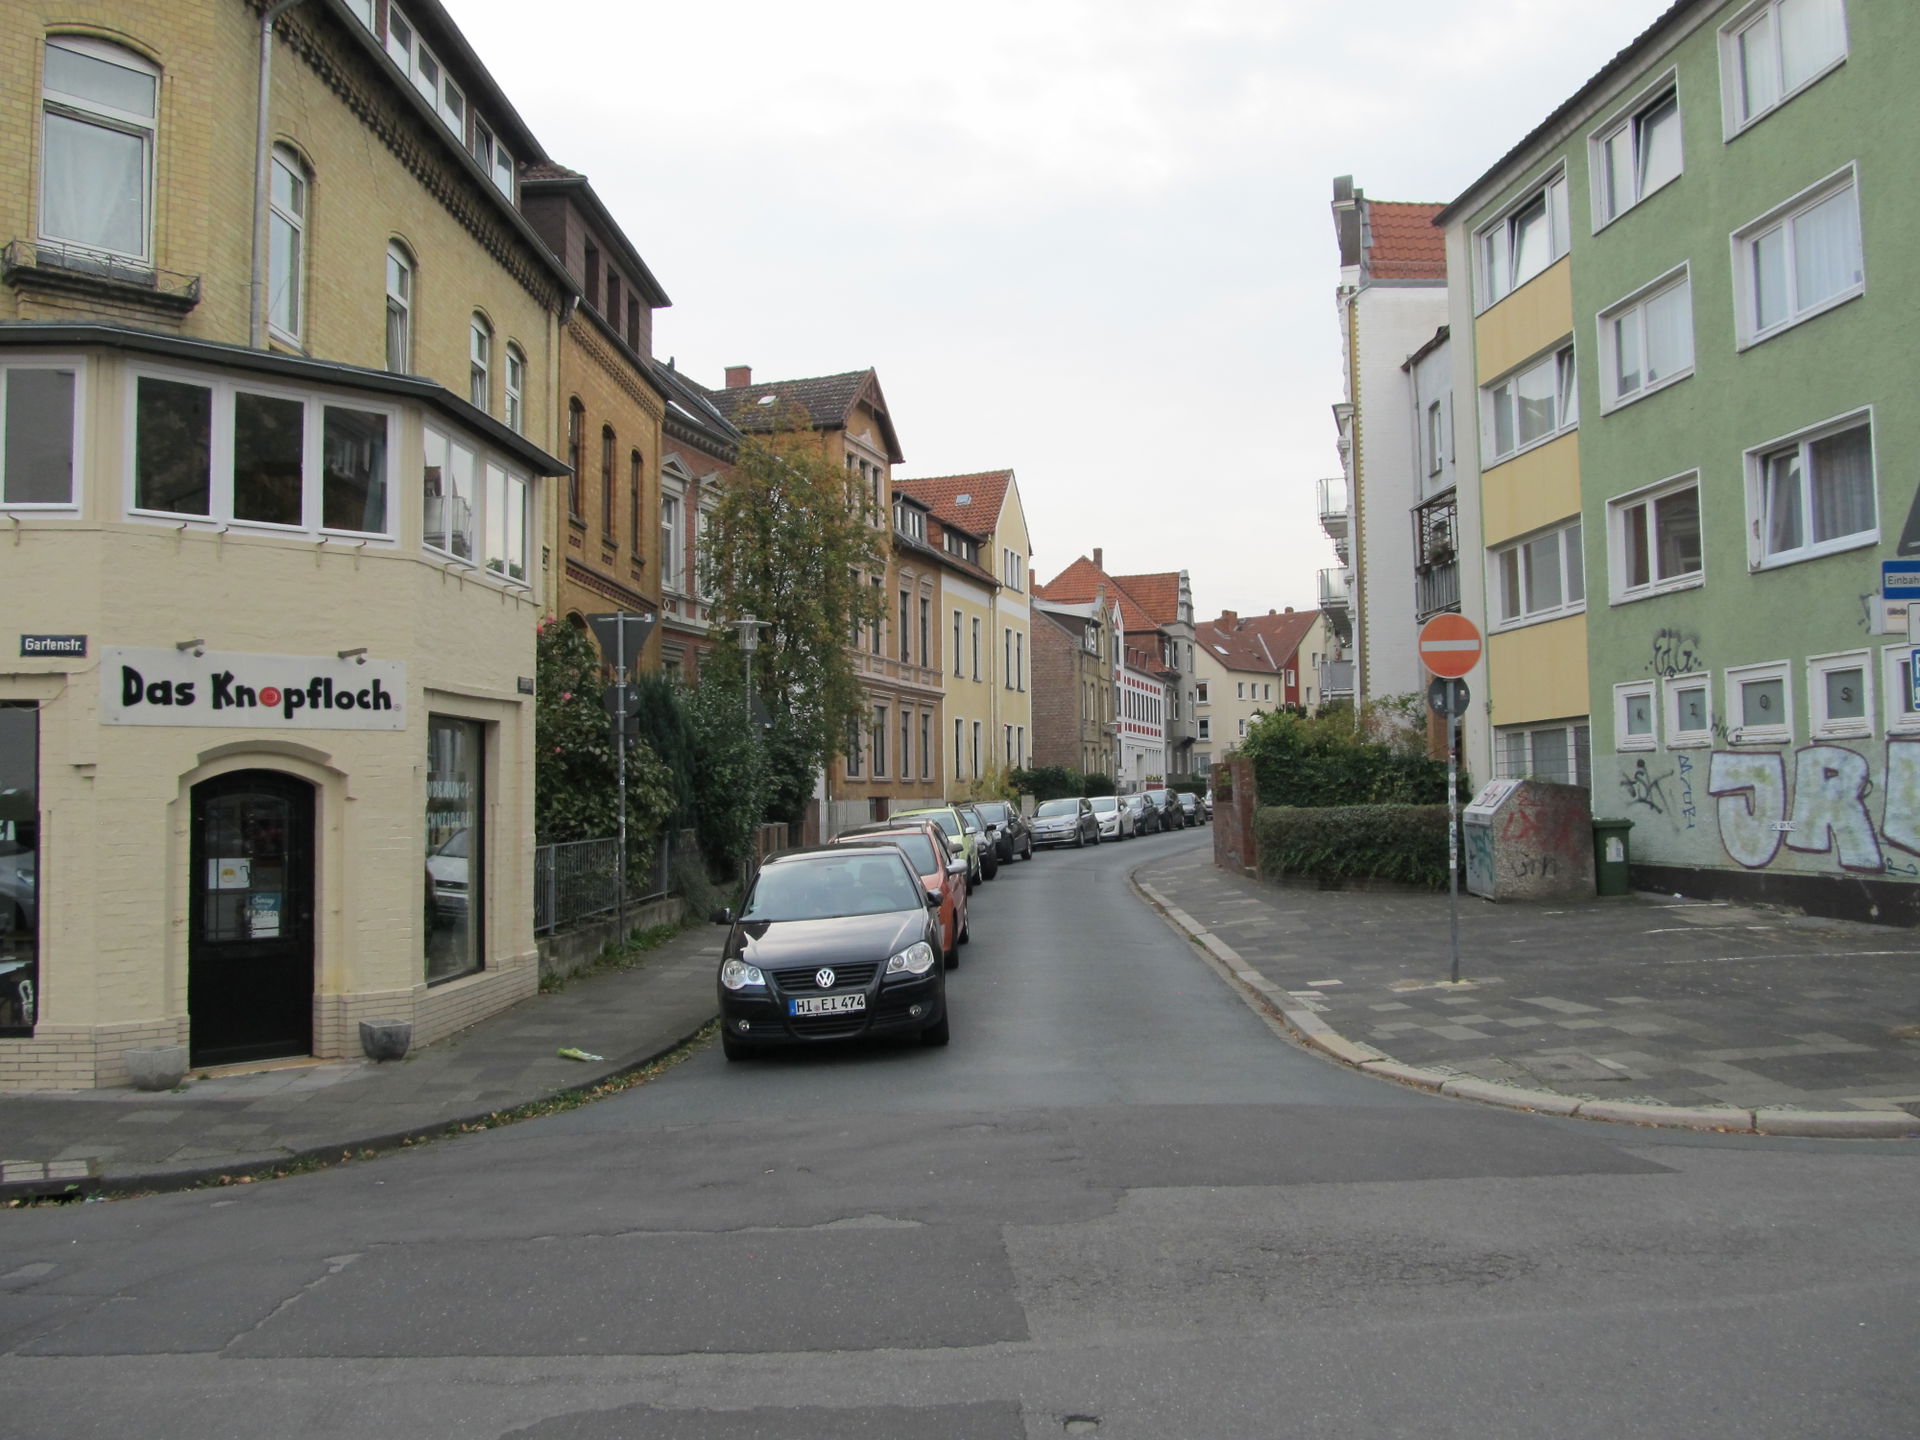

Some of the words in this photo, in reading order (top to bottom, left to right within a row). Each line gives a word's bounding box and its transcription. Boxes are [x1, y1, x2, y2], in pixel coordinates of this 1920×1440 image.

[25, 638, 83, 651] Gartenstr.
[122, 665, 196, 707] Das
[211, 670, 392, 719] Knopfloch
[796, 999, 812, 1013] HI
[821, 998, 838, 1011] EI
[841, 995, 864, 1009] 474
